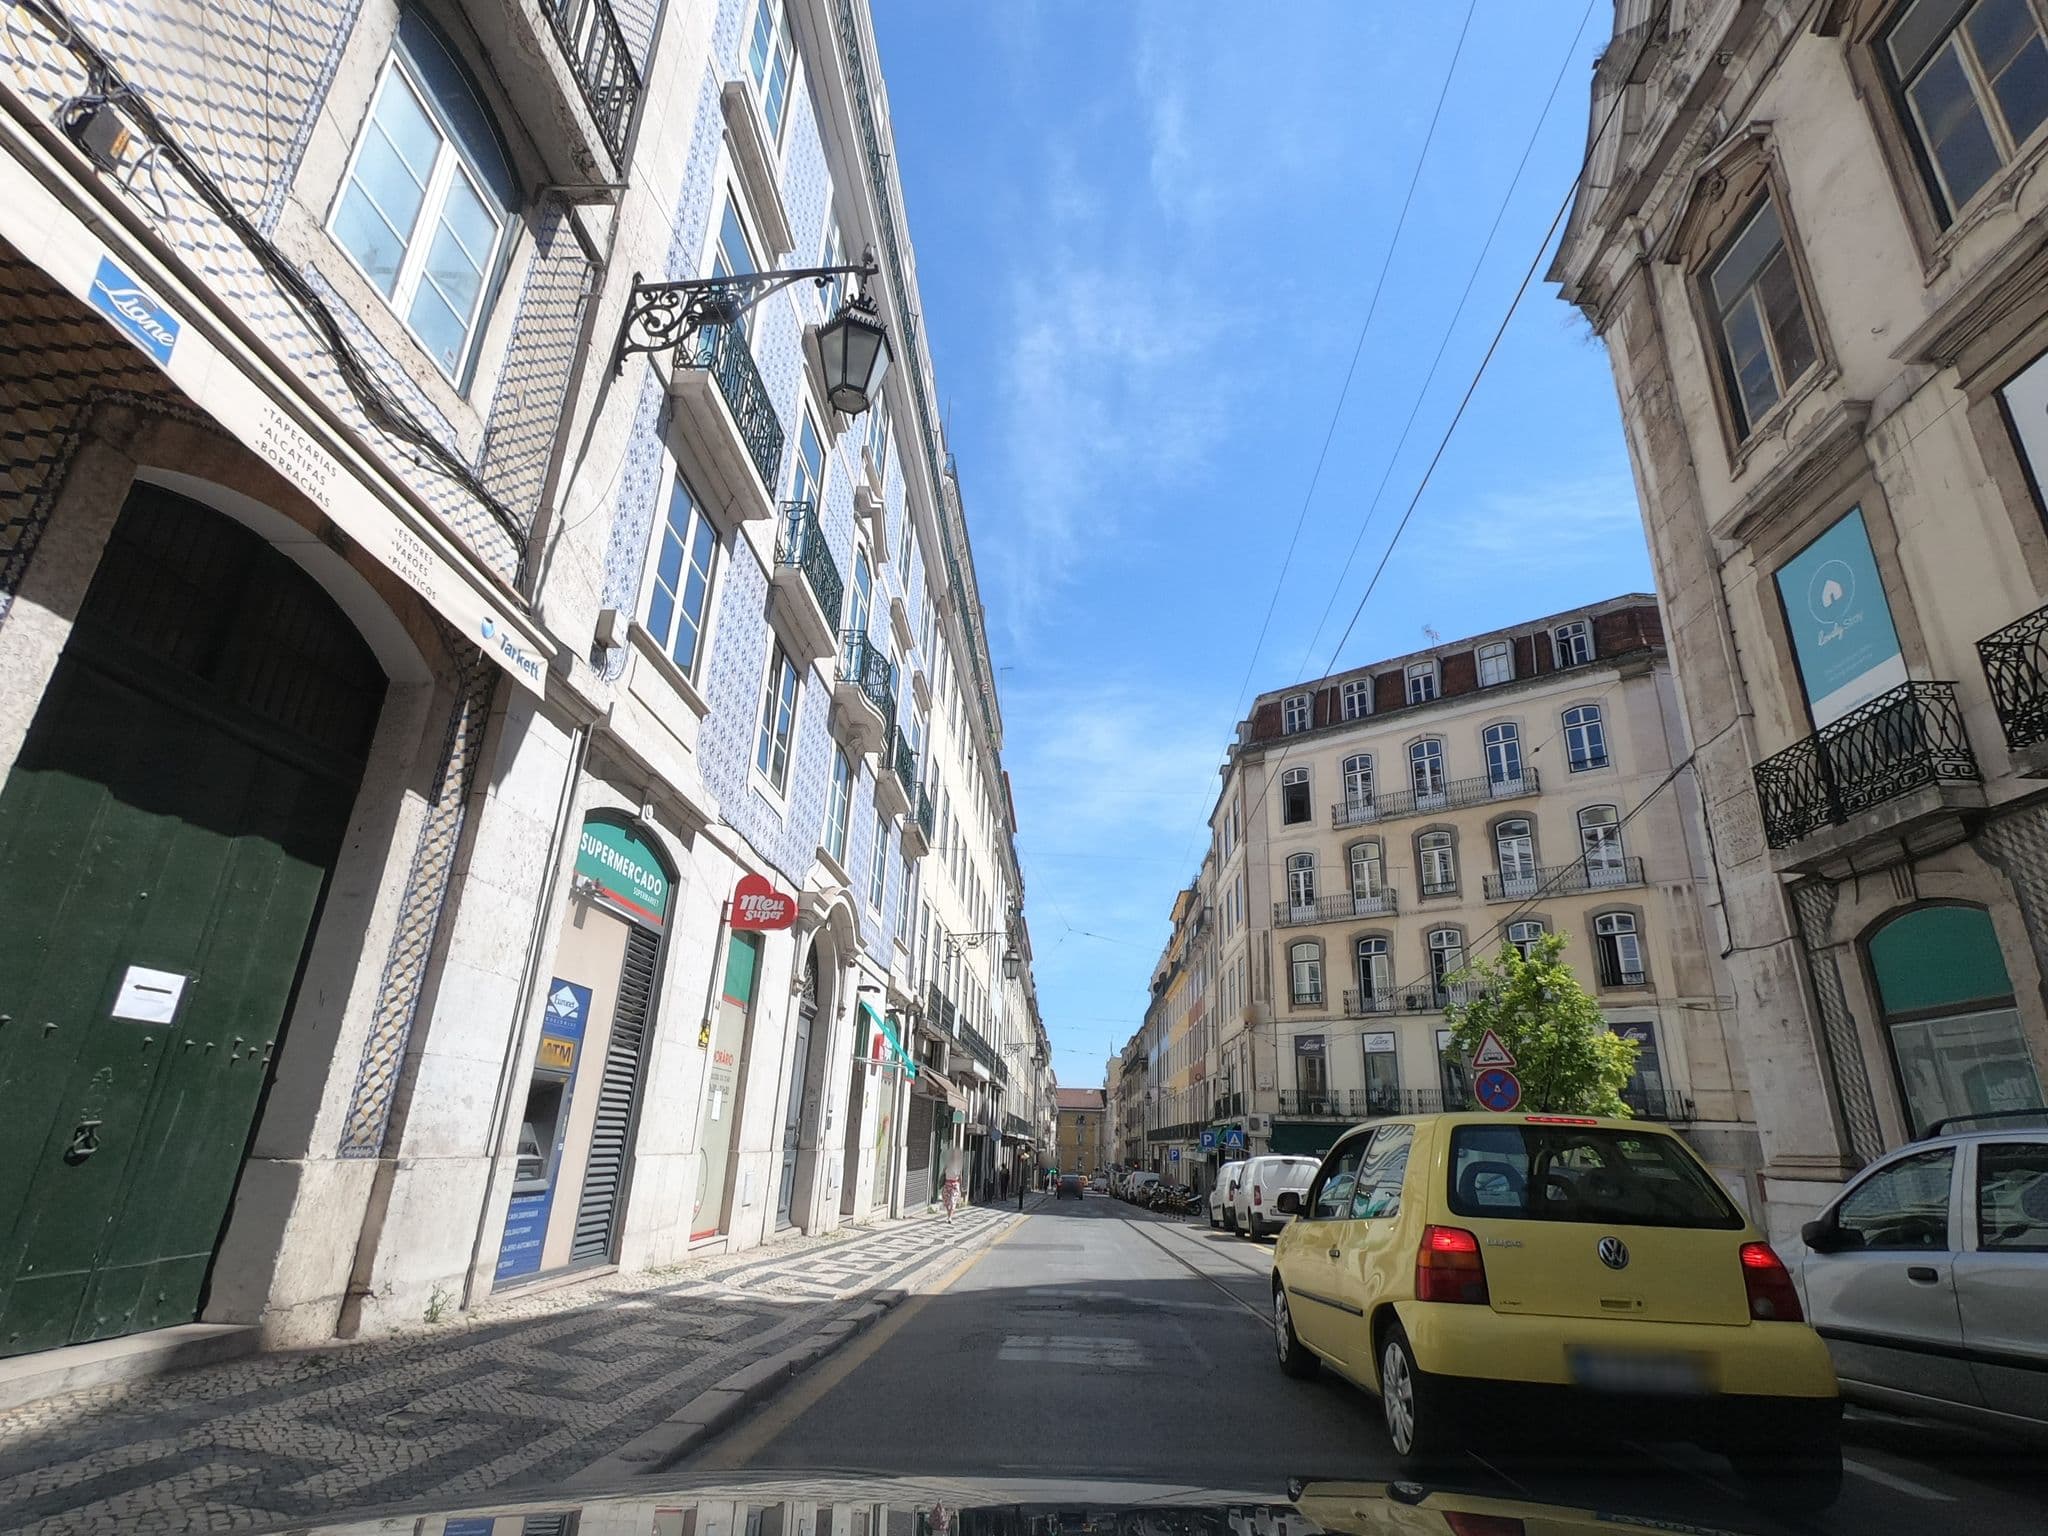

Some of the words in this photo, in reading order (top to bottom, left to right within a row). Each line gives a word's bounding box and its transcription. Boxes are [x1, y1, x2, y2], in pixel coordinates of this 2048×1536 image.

[264, 427, 326, 486] ALCATIFAS
[269, 408, 337, 478] TAPEÇARIAS
[260, 441, 330, 508] BORRACHAS
[398, 529, 433, 566] ESTORES
[499, 632, 539, 681] Tarkett
[580, 832, 663, 896] SUPERMERCADO
[1203, 1134, 1212, 1146] P
